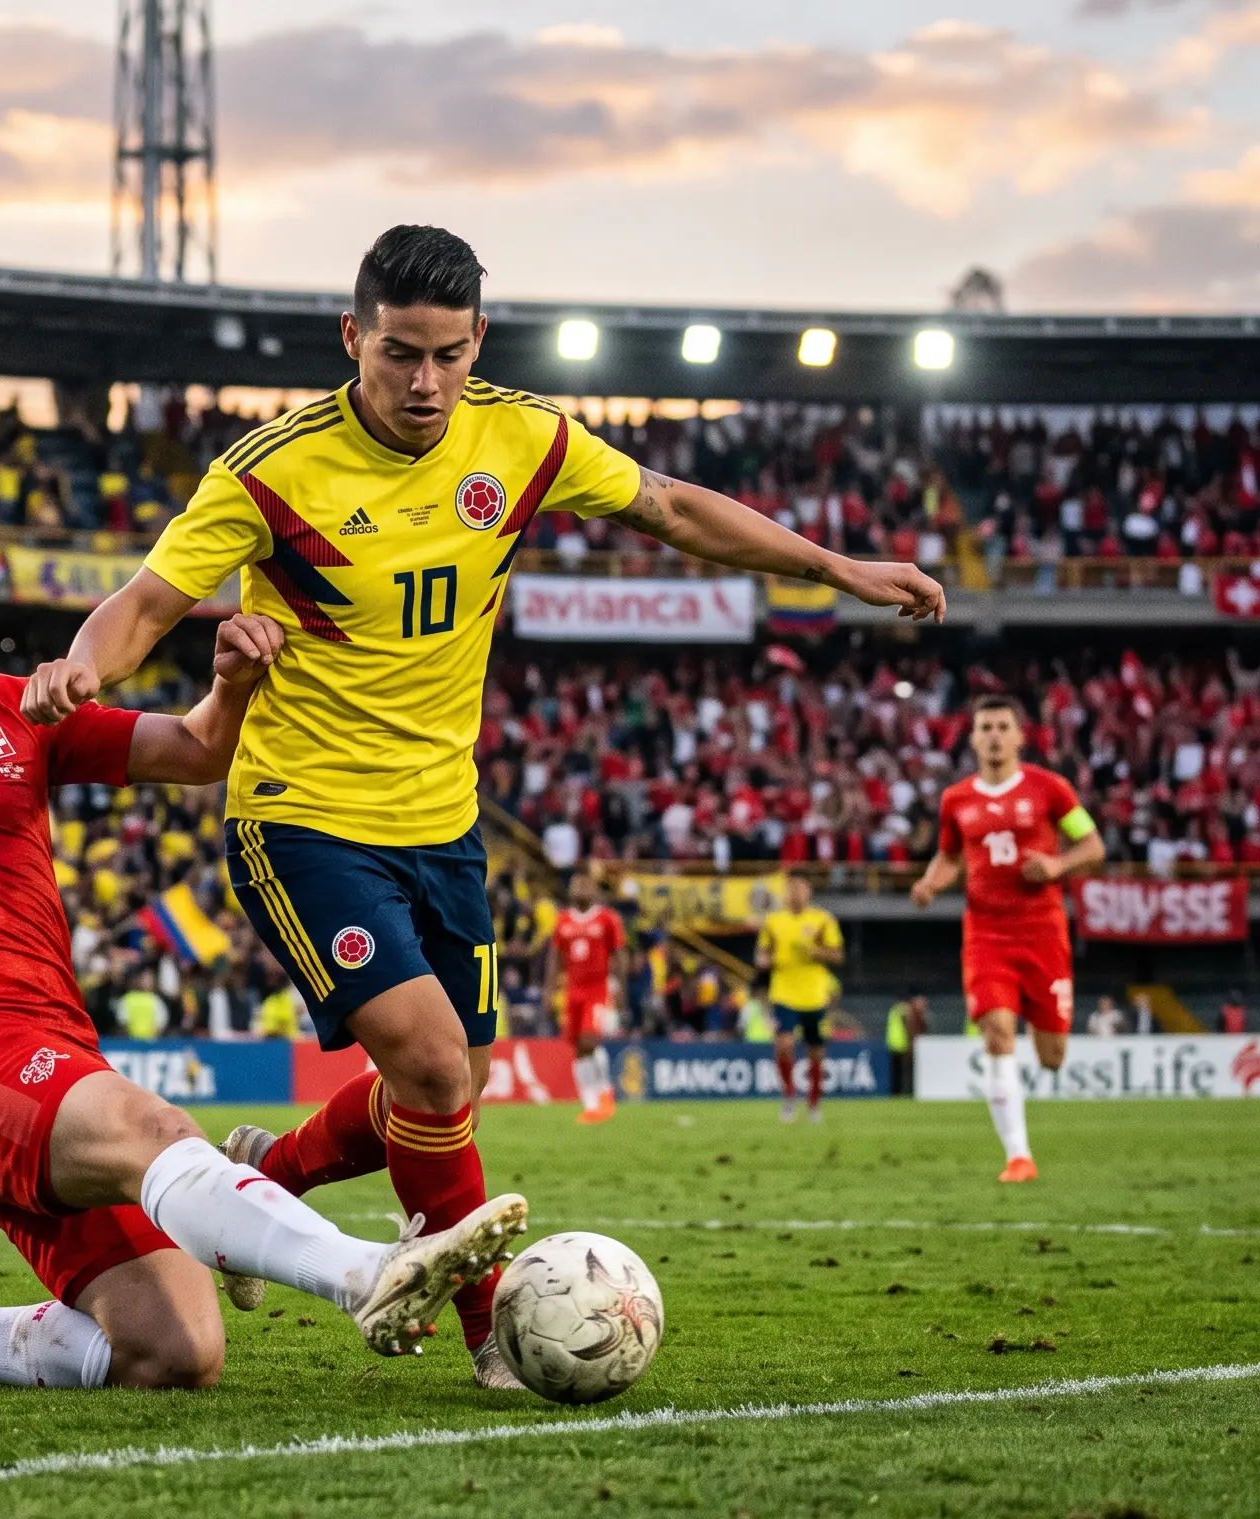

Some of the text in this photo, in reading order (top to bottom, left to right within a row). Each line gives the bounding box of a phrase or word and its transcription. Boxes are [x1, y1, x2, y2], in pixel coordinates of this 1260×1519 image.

[339, 524, 378, 535] adidas
[393, 565, 456, 638] 10
[524, 584, 700, 626] avianca
[653, 1058, 752, 1093] BANCO
